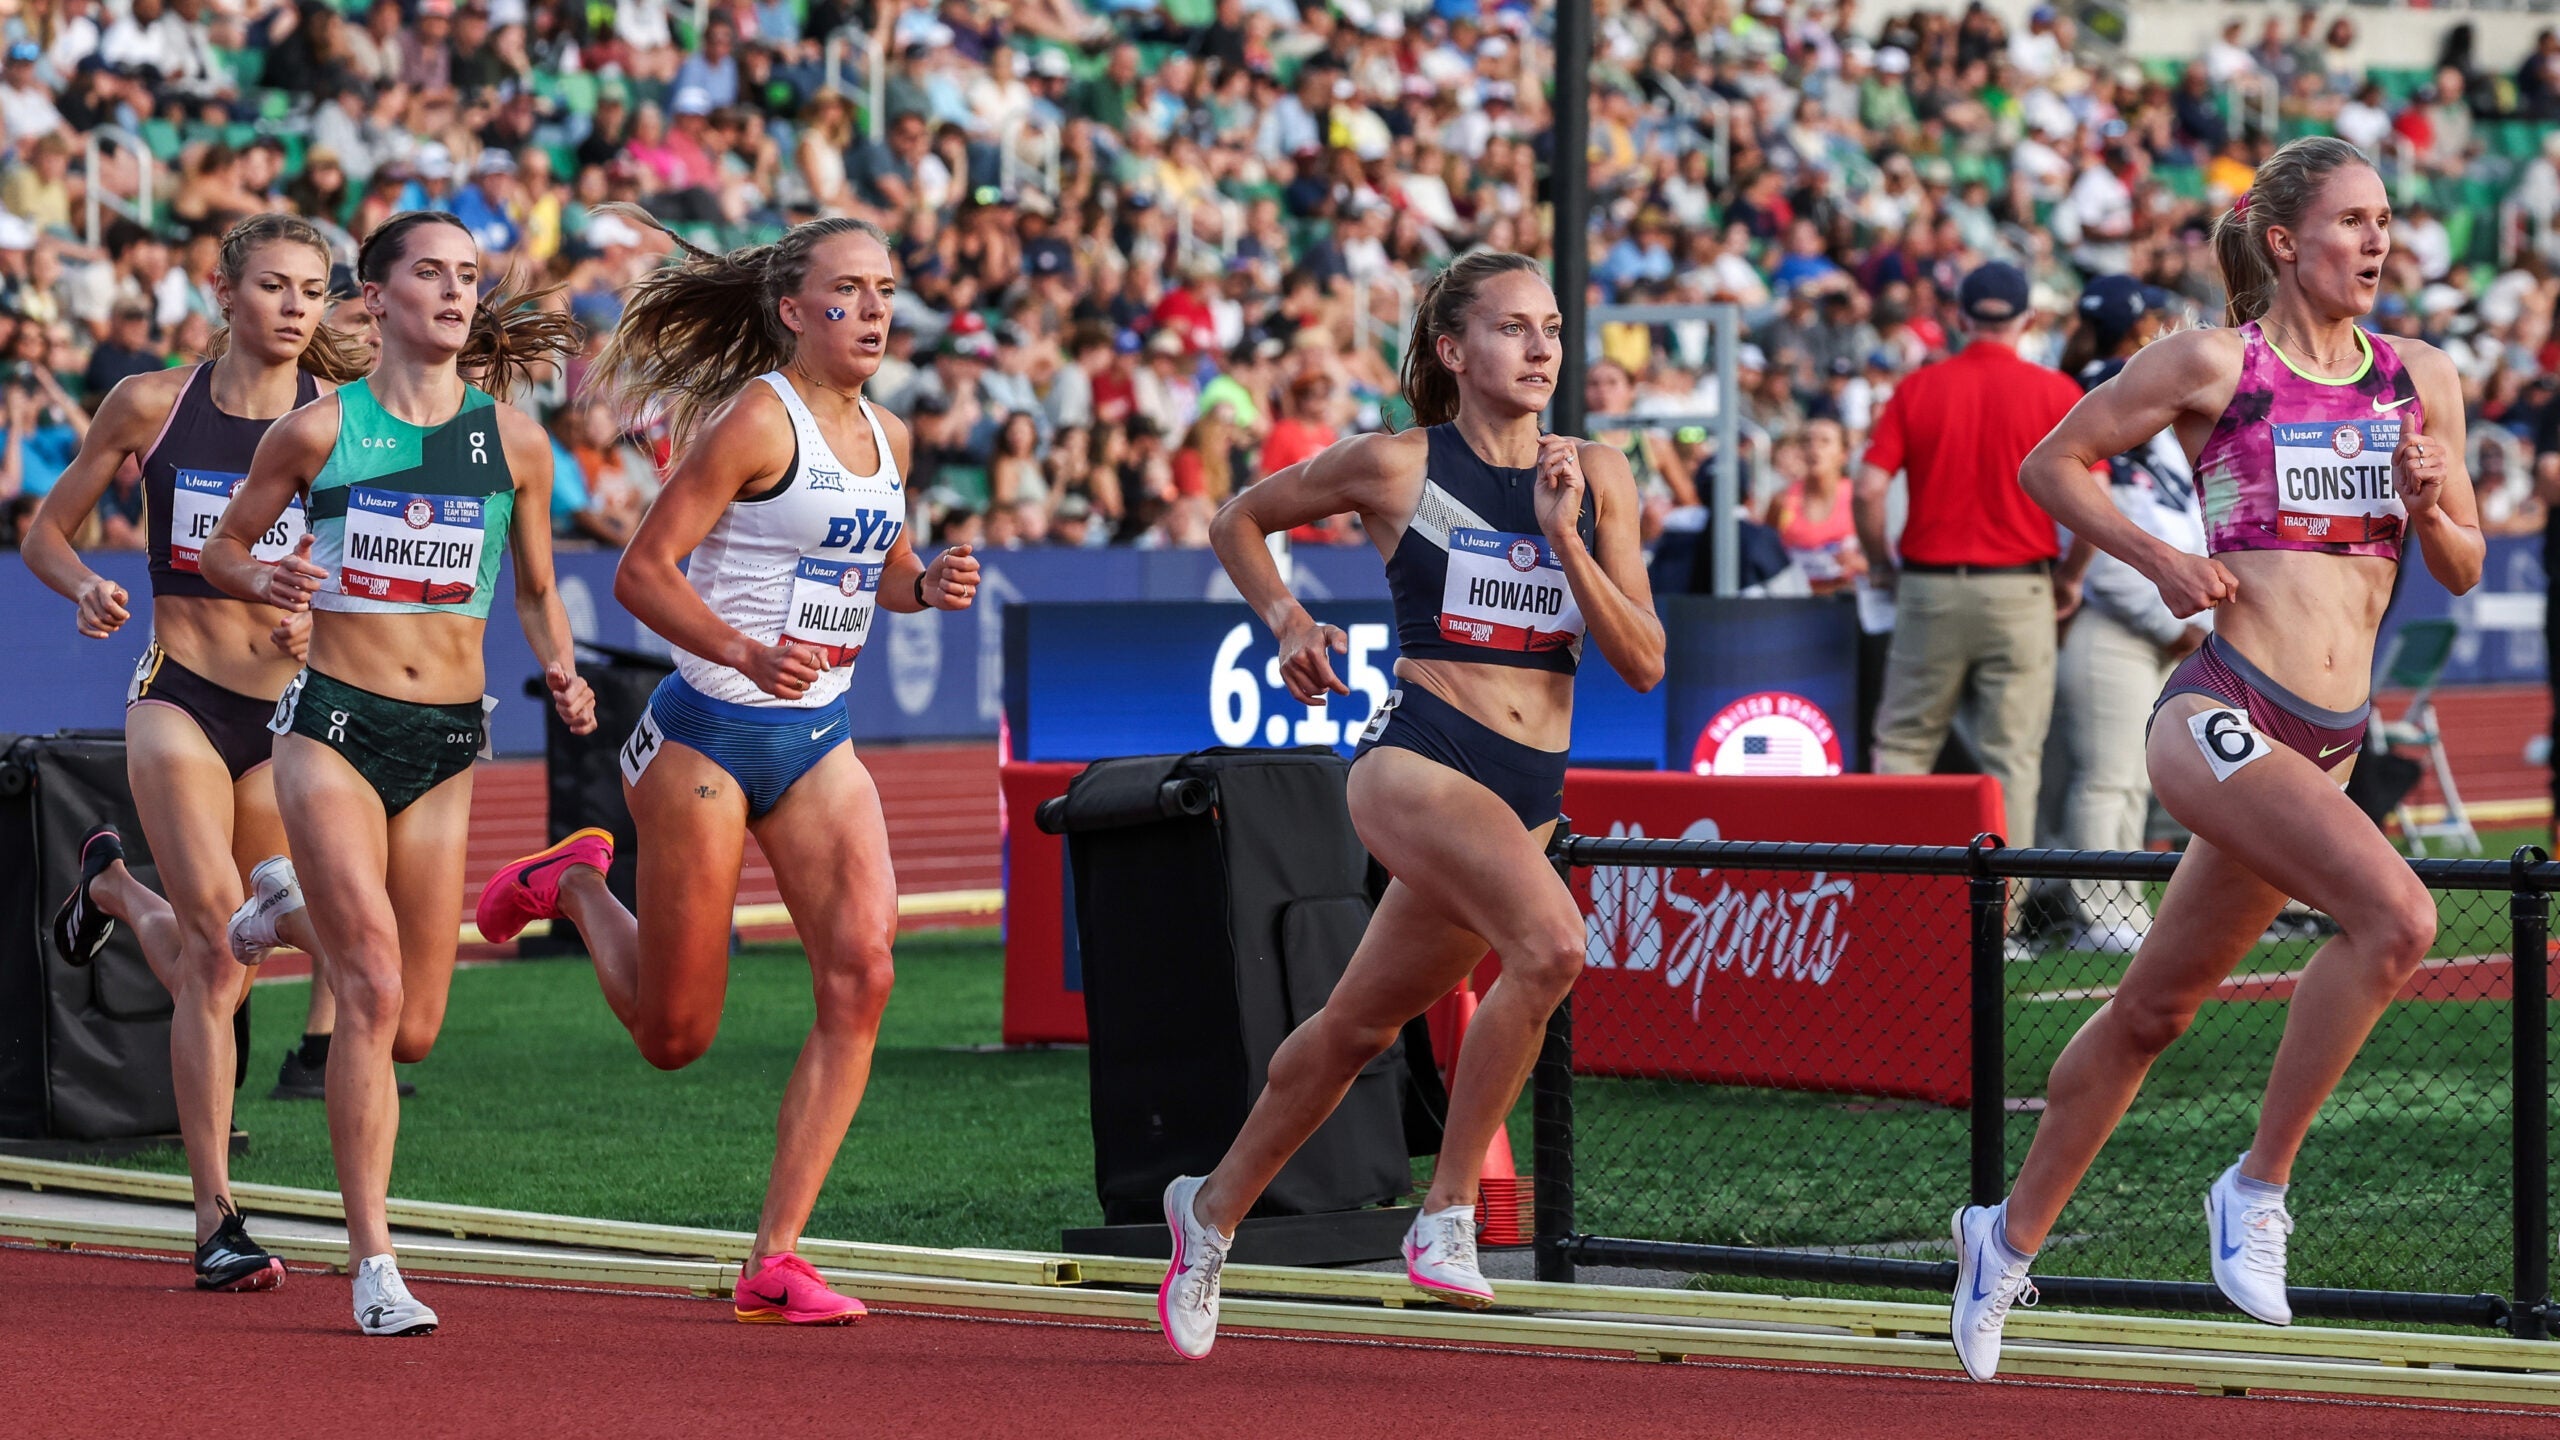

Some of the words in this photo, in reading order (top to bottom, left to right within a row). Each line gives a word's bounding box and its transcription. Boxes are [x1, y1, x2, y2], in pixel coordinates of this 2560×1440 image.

[827, 308, 842, 320] Y
[2383, 424, 2401, 433] OLYMP
[2294, 431, 2323, 440] USATF
[2371, 433, 2388, 441] TEAM
[2388, 433, 2400, 441] TRI
[361, 437, 397, 449] OAC
[195, 479, 223, 488] USATF
[2286, 465, 2401, 501] CONSTIE
[370, 499, 399, 509] USATF
[444, 500, 455, 508] U.S.
[456, 501, 480, 510] OLYMPIC
[444, 508, 460, 516] TEAM
[460, 509, 480, 518] TRIALS
[2284, 516, 2331, 528] TRACKTOWN
[820, 508, 903, 554] BYU
[2307, 525, 2328, 536] 2024
[350, 532, 474, 569] MARKEZICH
[1472, 540, 1502, 549] USATF
[178, 551, 201, 562] TRACK
[814, 568, 838, 578] USATF
[348, 573, 391, 588] TRACKTOWN
[368, 585, 388, 595] 2024
[1468, 577, 1563, 616] HOWARD
[798, 602, 871, 633] HALLADAY
[1448, 619, 1494, 634] TRACKTOWN
[1470, 631, 1491, 643] 2024
[446, 732, 473, 744] OAC
[2205, 710, 2255, 763] 6
[621, 721, 655, 773] 14
[1662, 817, 1855, 1023] Sports
